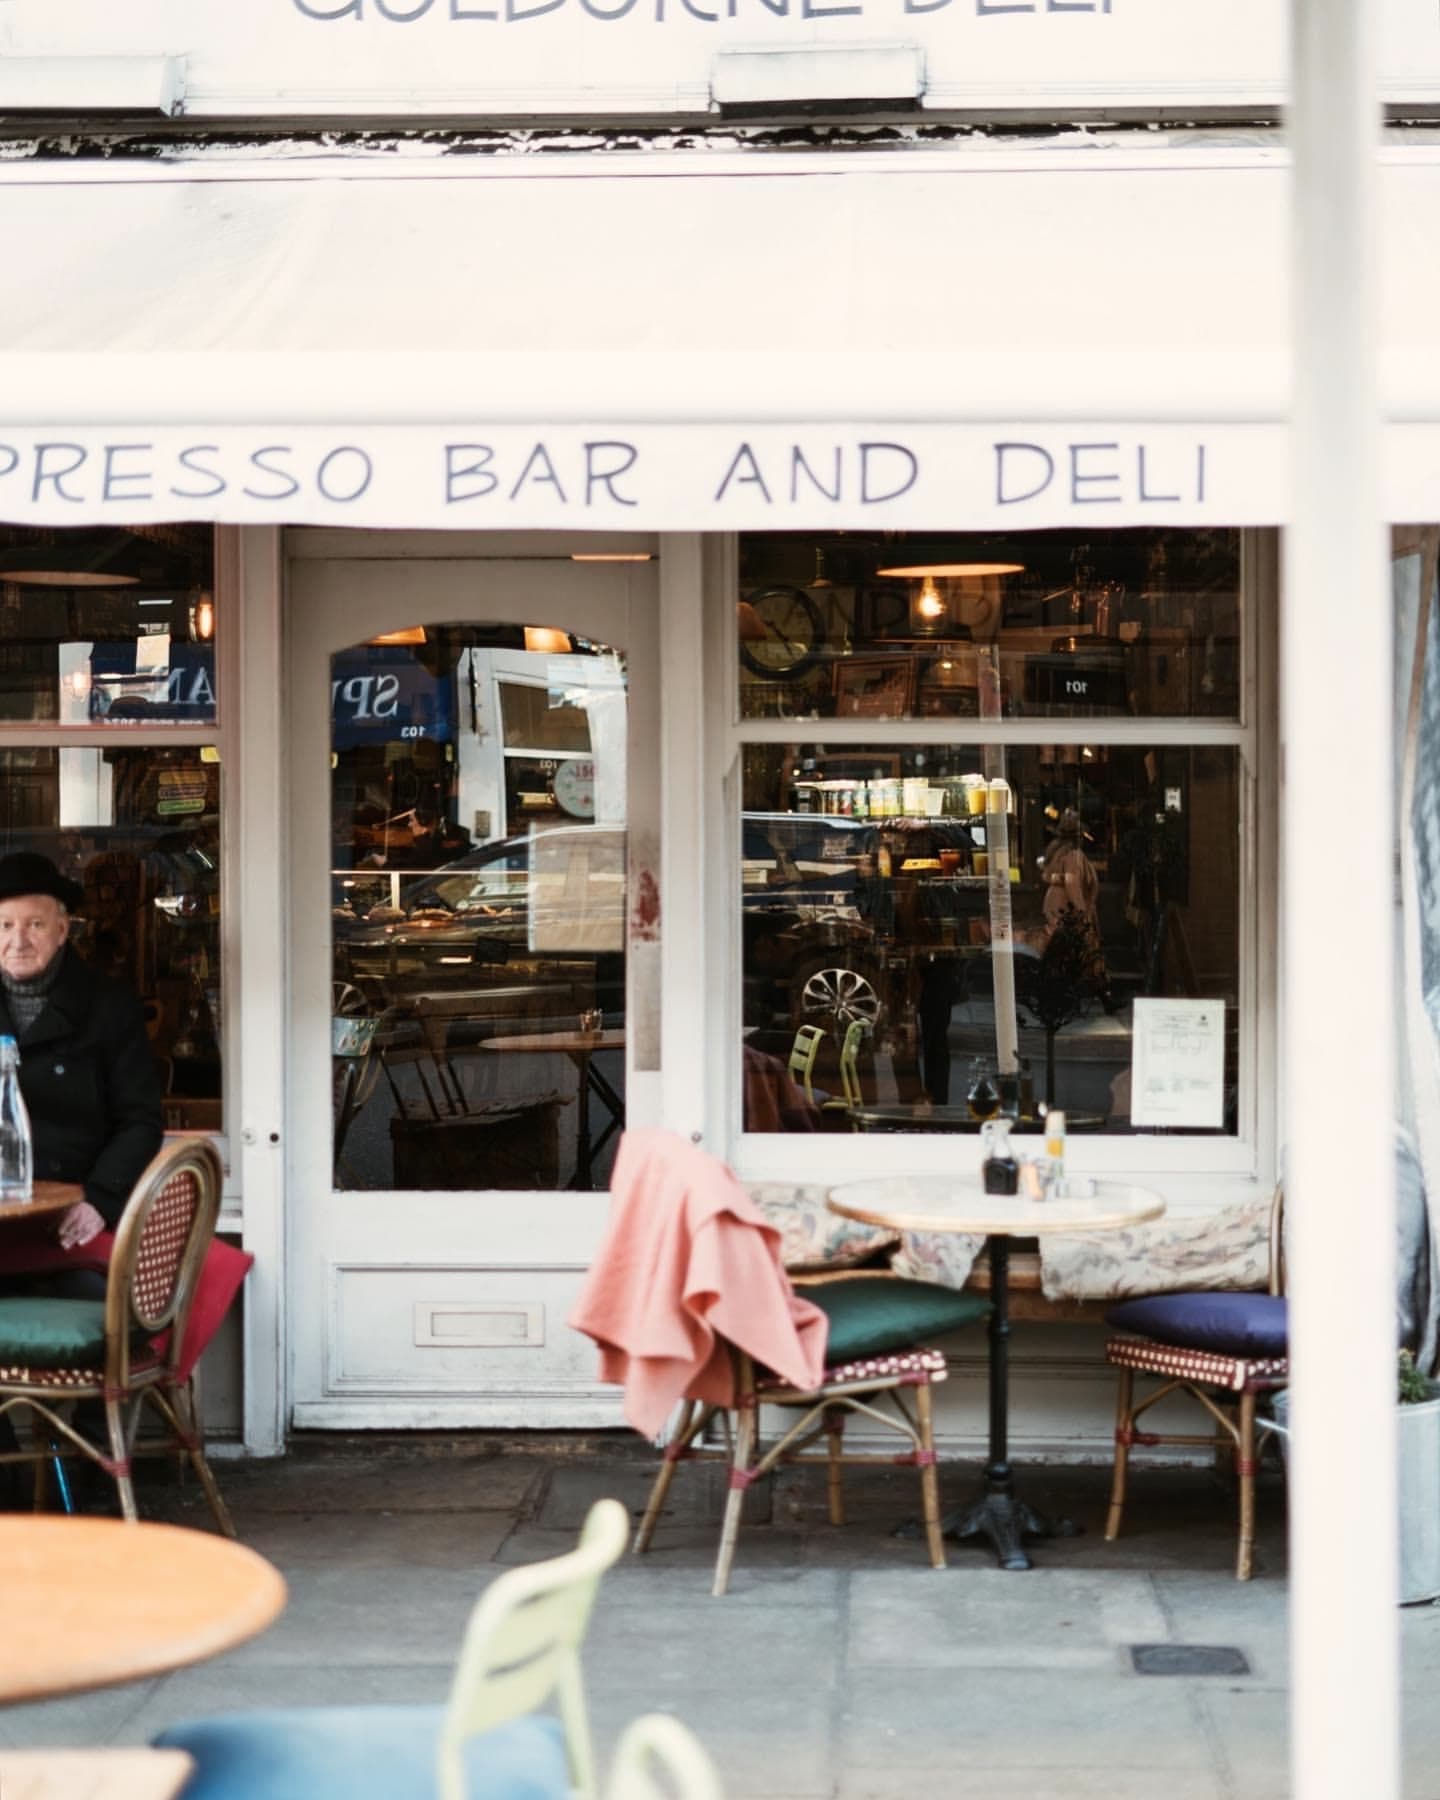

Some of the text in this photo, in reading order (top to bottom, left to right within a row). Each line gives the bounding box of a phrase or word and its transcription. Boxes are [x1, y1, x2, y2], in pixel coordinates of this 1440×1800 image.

[444, 443, 638, 505] BAR
[714, 442, 919, 504] AND
[994, 442, 1205, 504] DELI
